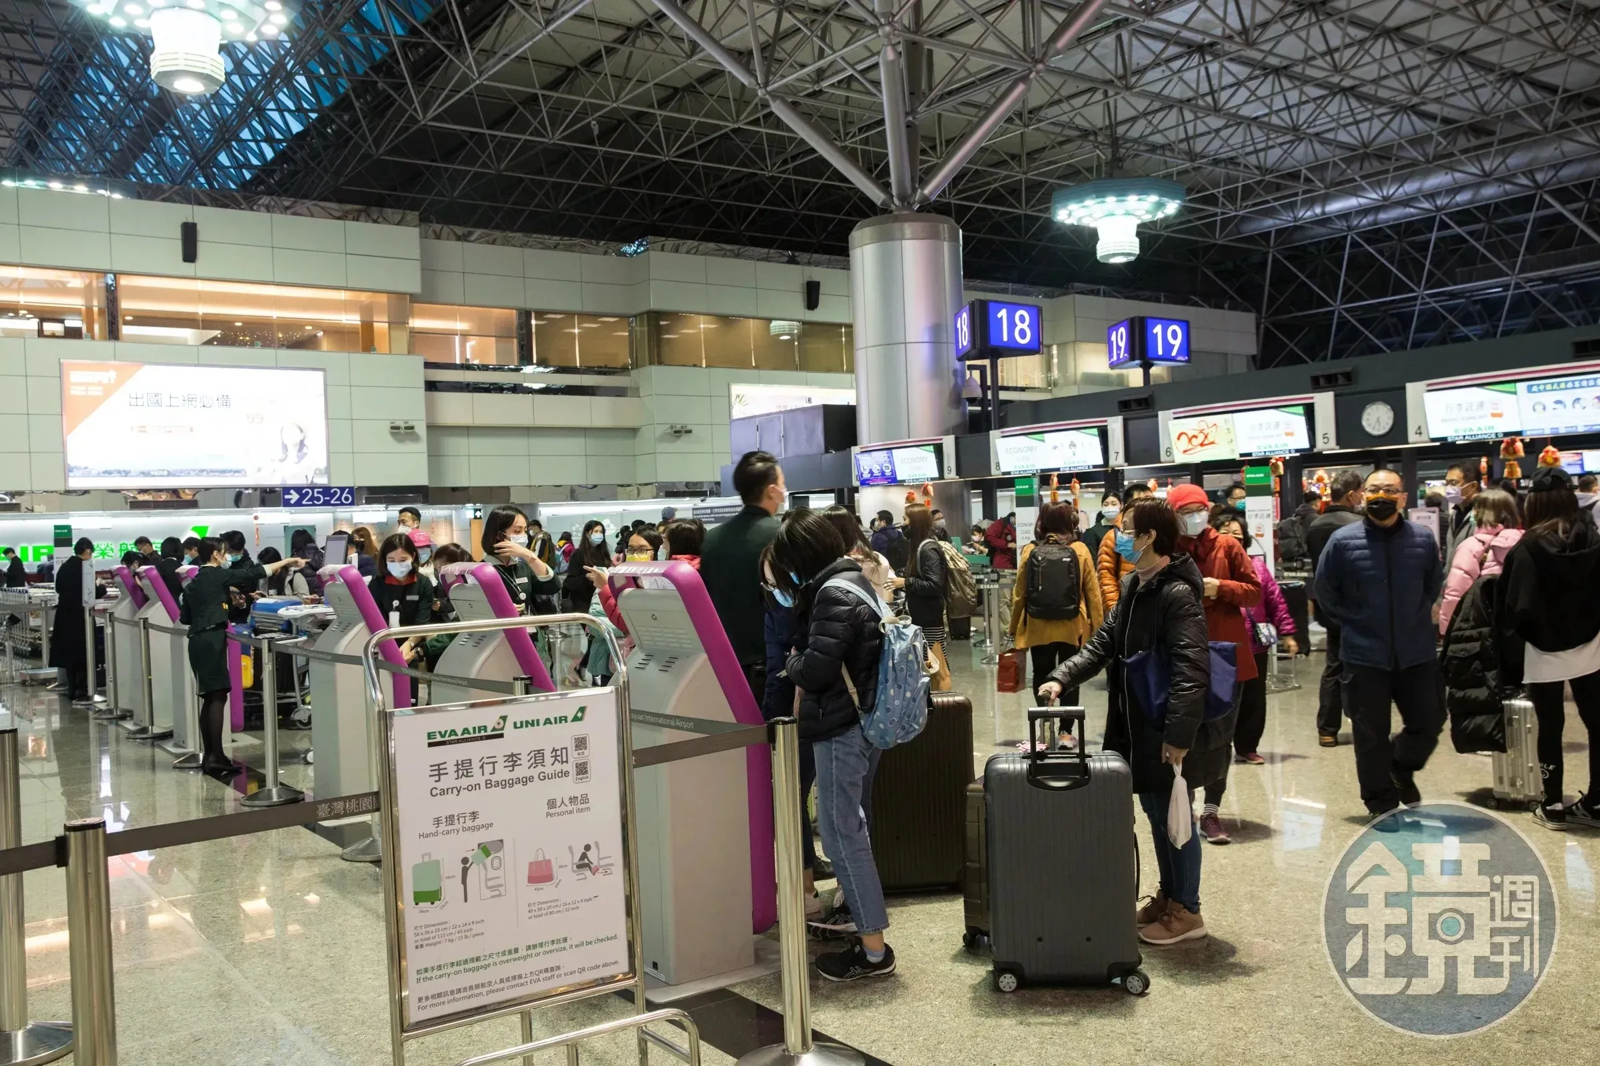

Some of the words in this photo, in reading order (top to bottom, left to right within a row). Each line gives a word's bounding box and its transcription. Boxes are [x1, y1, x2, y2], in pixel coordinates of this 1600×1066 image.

[957, 312, 968, 349] 18
[997, 308, 1031, 344] 18
[1111, 327, 1126, 360] 19
[1153, 324, 1182, 356] 19
[128, 392, 231, 408] 出國上網必備
[1322, 433, 1330, 444] 5
[1415, 425, 1422, 437] 4
[1005, 446, 1037, 455] ECONOMY
[1114, 452, 1120, 461] 7
[1166, 447, 1171, 457] 6
[947, 466, 952, 474] 9
[996, 462, 1000, 470] 8
[302, 488, 352, 504] 25-26
[513, 719, 540, 730] UNI
[543, 716, 568, 726] AIR
[645, 714, 675, 725] International
[676, 719, 694, 729] Airport
[428, 747, 569, 783] 手提行李須知
[430, 782, 481, 797] Carry-on
[485, 774, 534, 789] Baggage
[538, 769, 570, 781] Guide
[546, 793, 590, 810] 個人物品
[432, 811, 480, 828] 手提行李
[546, 808, 574, 818] Personal
[576, 806, 590, 814] item
[418, 828, 460, 839] Hand-carry
[462, 822, 494, 832] baggage
[424, 920, 448, 929] Dimension
[435, 970, 462, 980] carry-on
[464, 964, 491, 973] baggage
[499, 953, 533, 965] overweight
[542, 946, 568, 955] oversize,
[594, 934, 618, 945] checked.
[447, 993, 484, 1004] information,
[486, 987, 505, 996] please
[506, 980, 528, 990] contact
